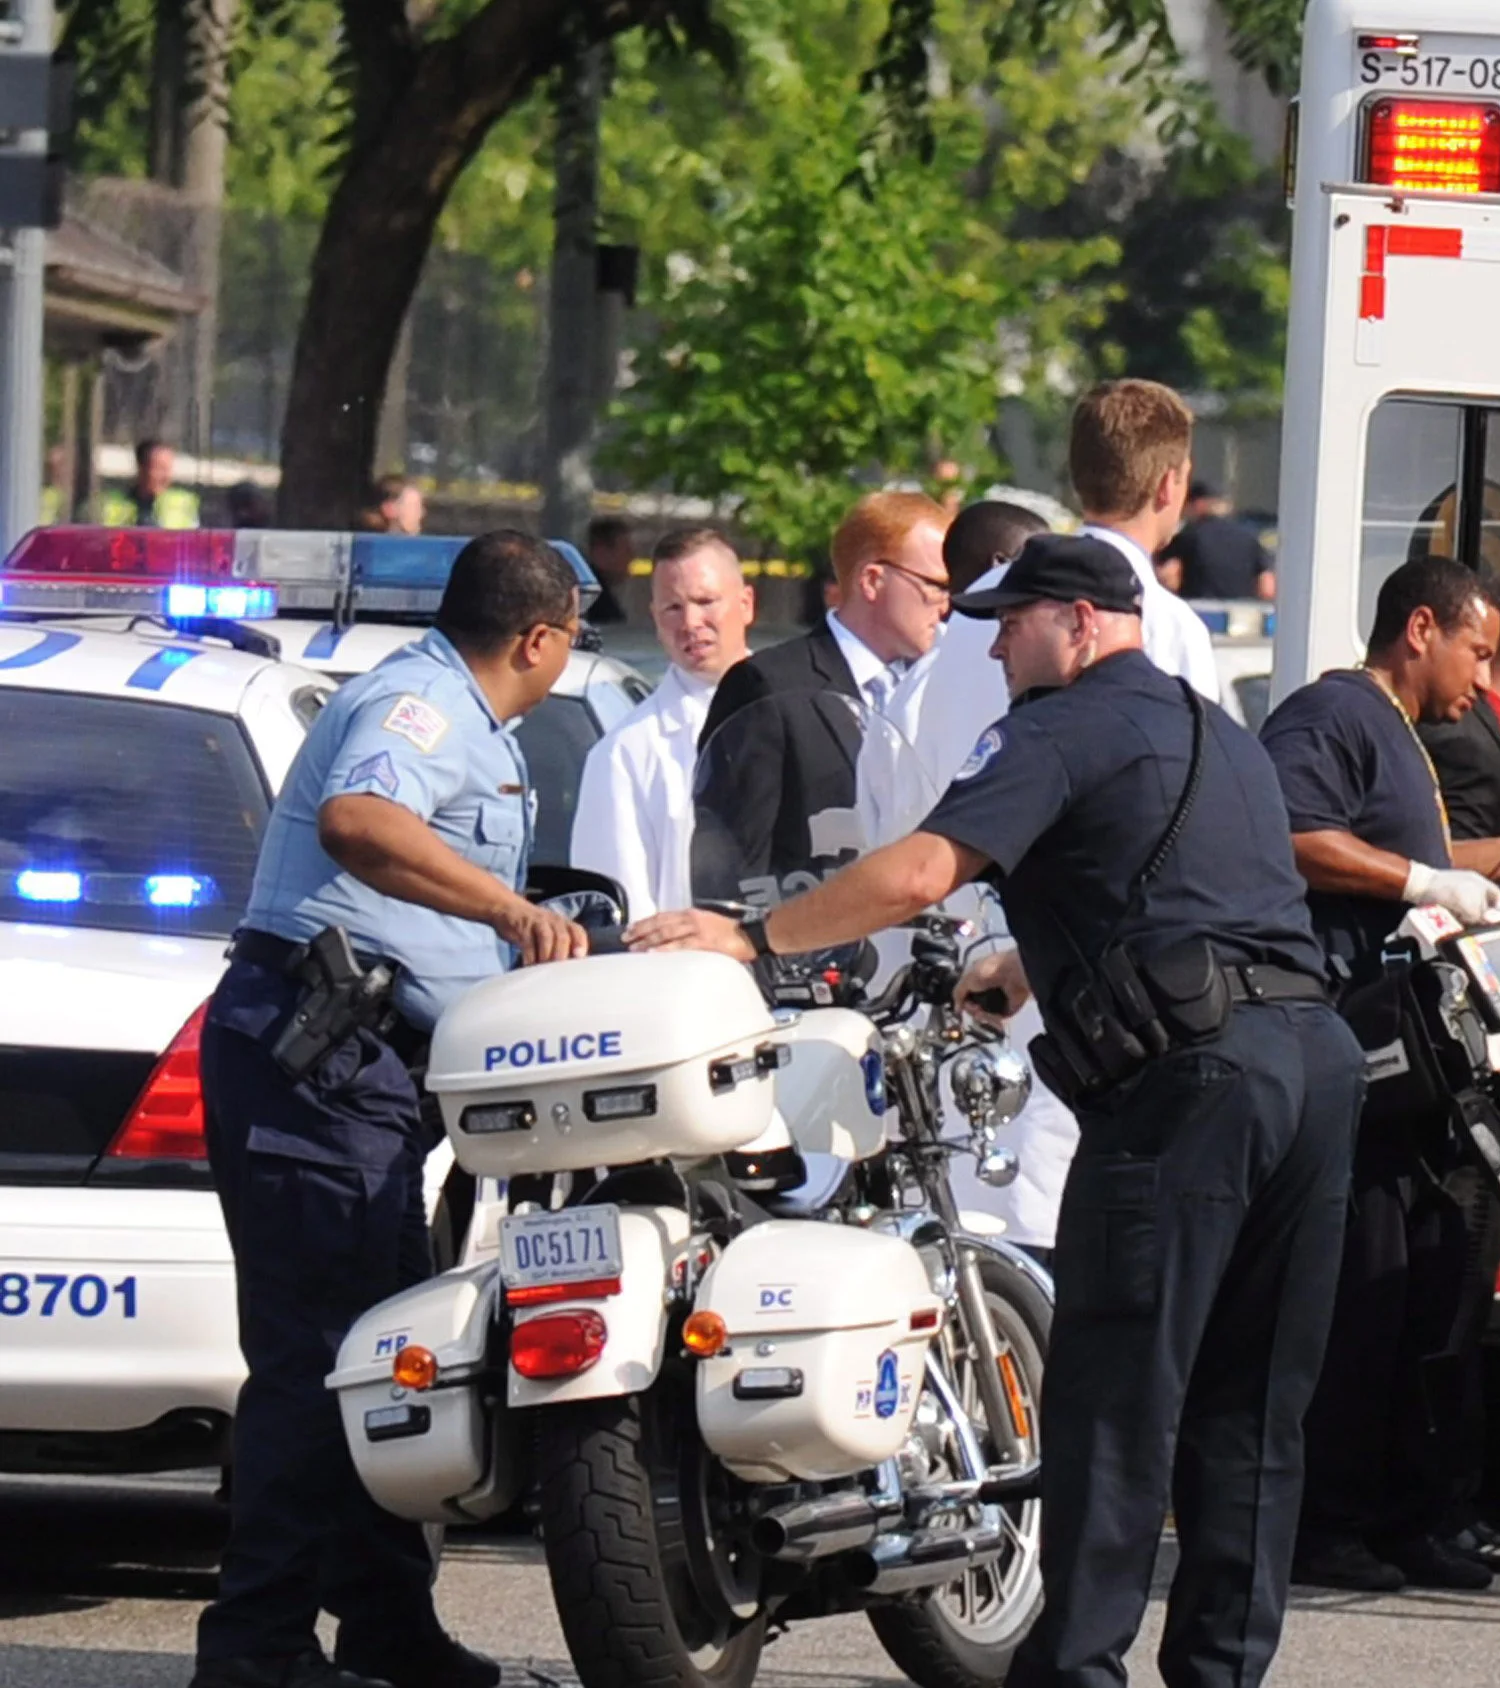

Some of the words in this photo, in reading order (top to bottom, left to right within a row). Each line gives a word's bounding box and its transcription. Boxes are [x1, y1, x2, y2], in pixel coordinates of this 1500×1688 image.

[485, 1031, 622, 1072] POLICE
[515, 1227, 608, 1269] DC5171
[0, 1273, 136, 1318] 8701
[760, 1289, 792, 1307] DC
[376, 1335, 408, 1356] MP
